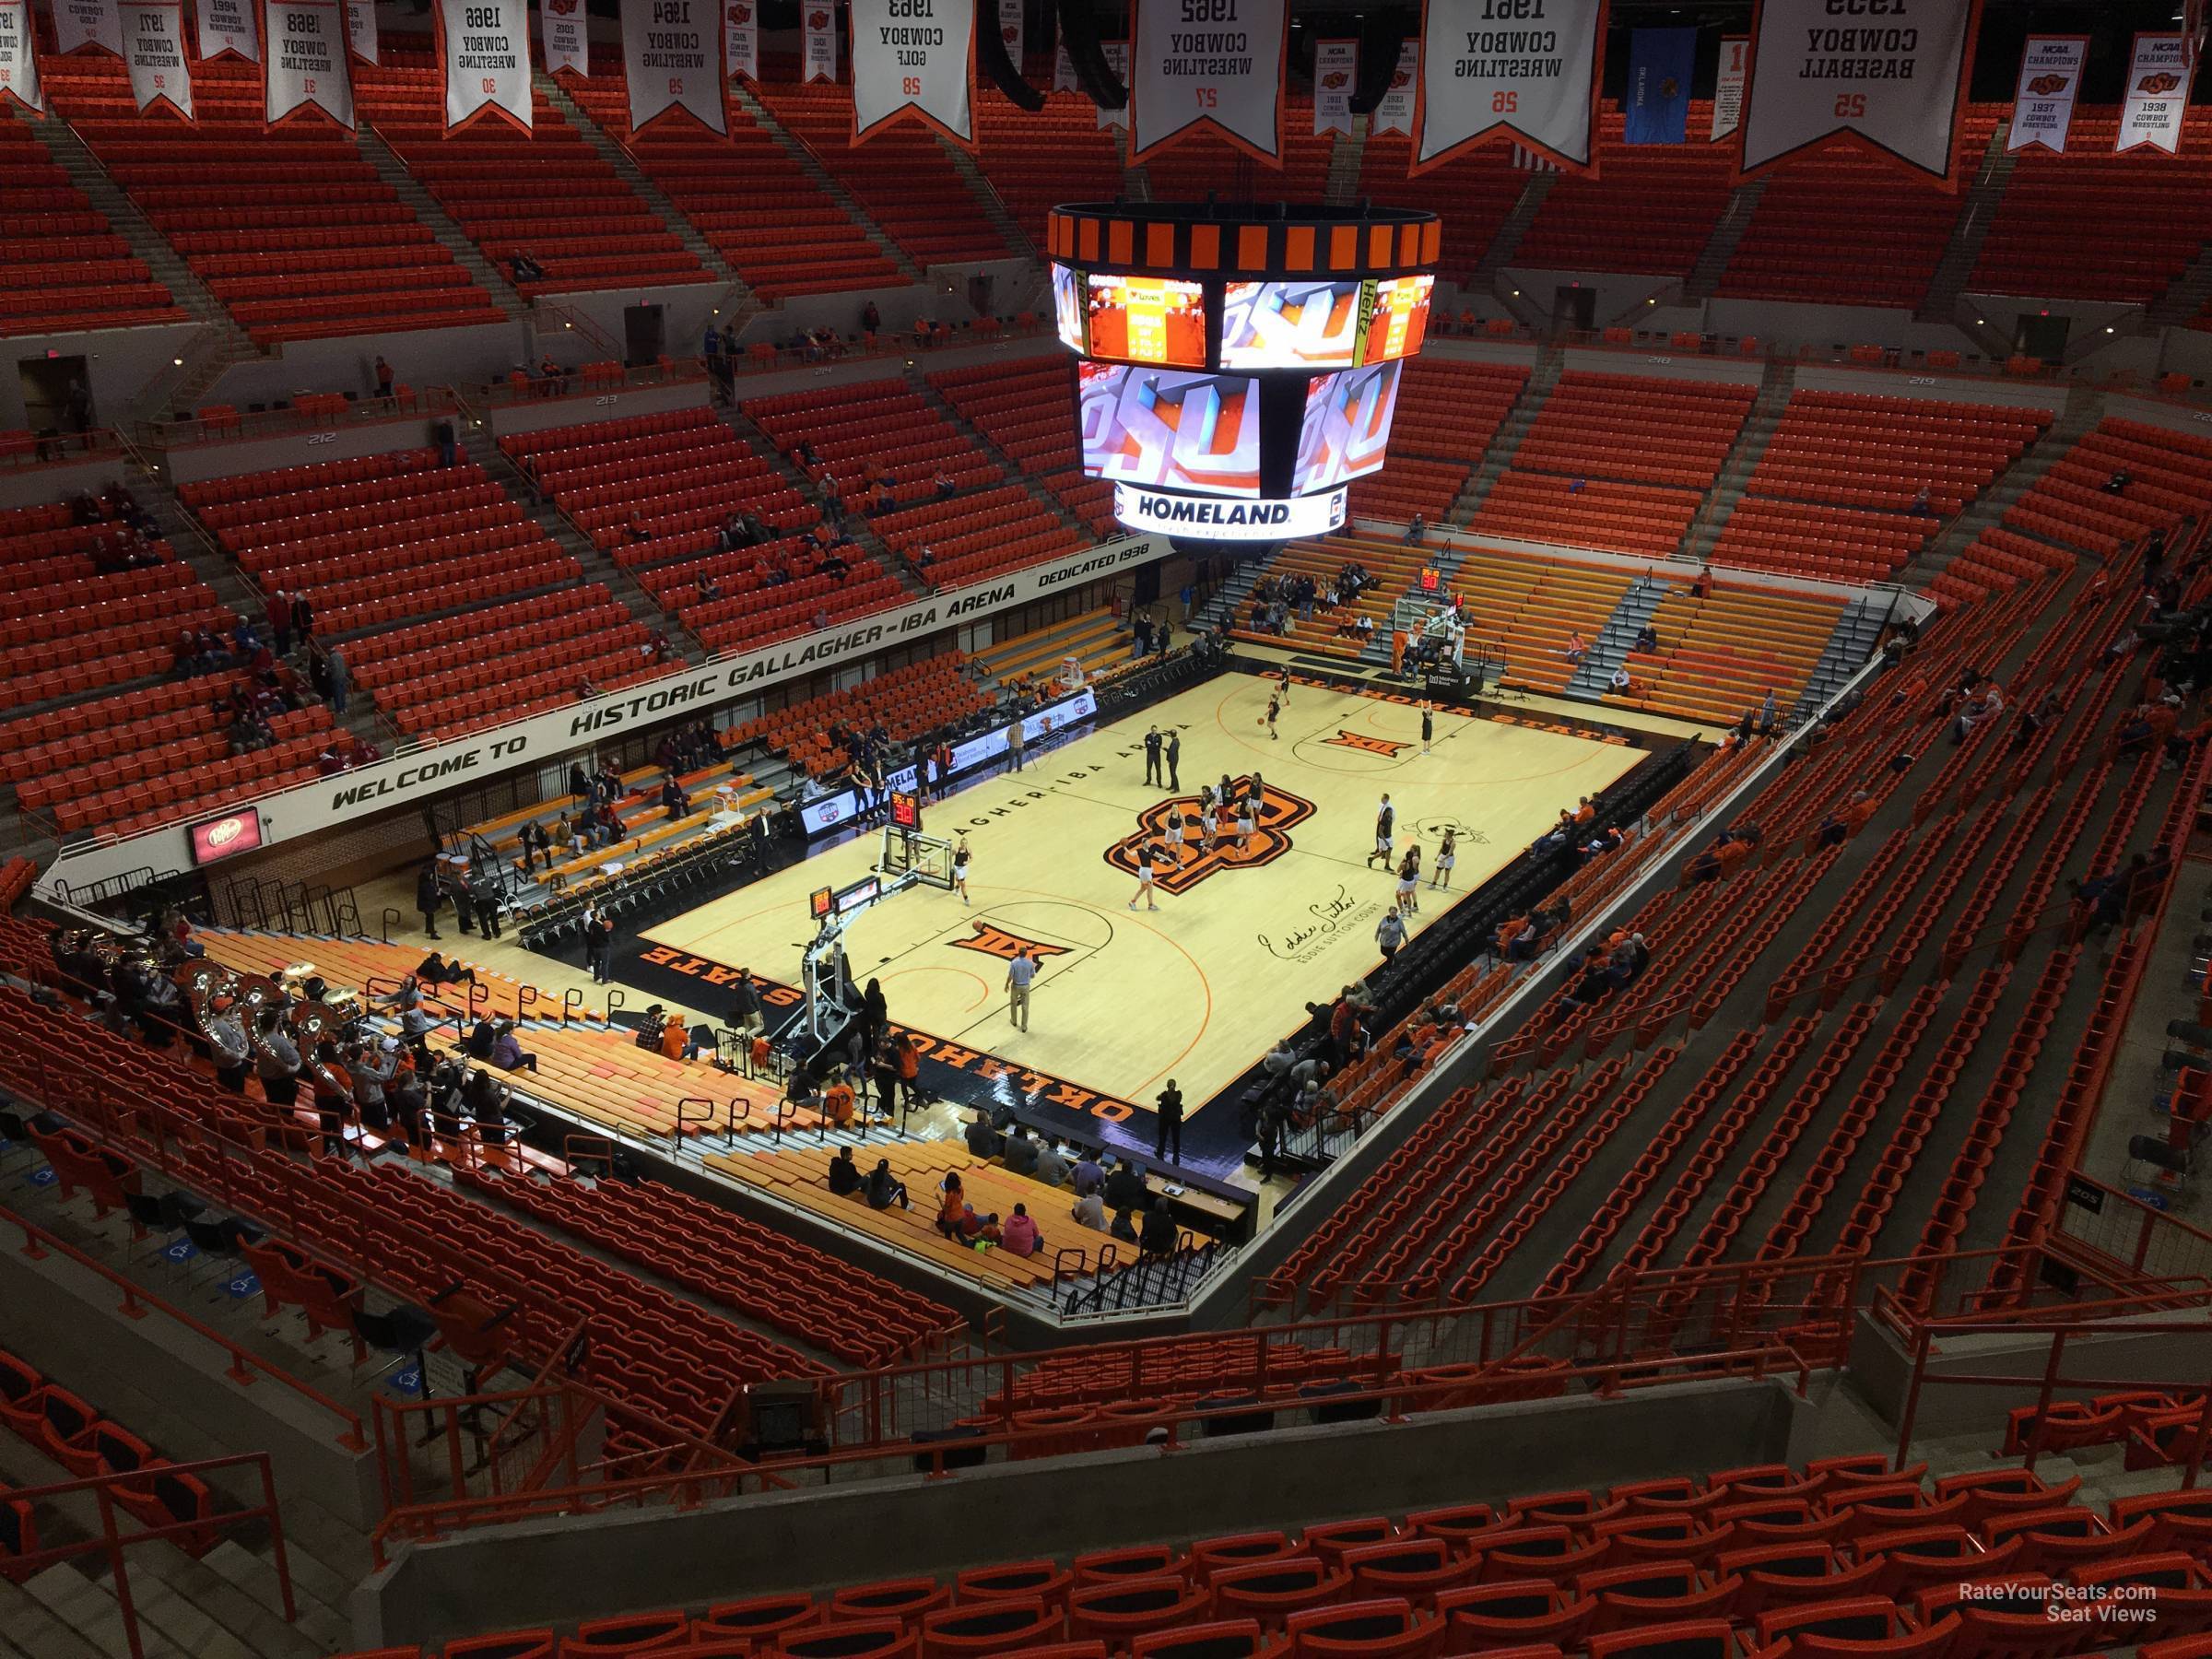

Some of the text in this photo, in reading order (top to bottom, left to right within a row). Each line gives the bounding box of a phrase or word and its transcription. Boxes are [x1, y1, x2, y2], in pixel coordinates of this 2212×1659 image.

[69, 6, 104, 16] COWBOY
[213, 0, 237, 12] 1994
[210, 14, 241, 24] COWBOY
[209, 24, 245, 33] WRESTLING
[2028, 56, 2078, 65] CHAMPIONS
[1636, 66, 1646, 107] OKLAHOMA
[2032, 103, 2055, 112] 1937
[2142, 103, 2166, 112] 1938
[1359, 283, 1375, 335] Hertz
[1909, 376, 1936, 385] 219
[595, 394, 618, 406] 213
[308, 432, 337, 444] 212
[1139, 495, 1290, 524] HOMELAND
[332, 543, 1149, 810] WELCOME TO HISTORIC GALLAGHER-IBA ARENA DEDICATED 1938
[1259, 671, 1631, 747] OKLAHOMA STATE
[892, 794, 914, 807] 35:10
[1257, 884, 1356, 959] Eddie Sutton
[1297, 902, 1382, 964] EDDIE SUTTON COURT
[889, 1026, 1135, 1124] OKLAHO
